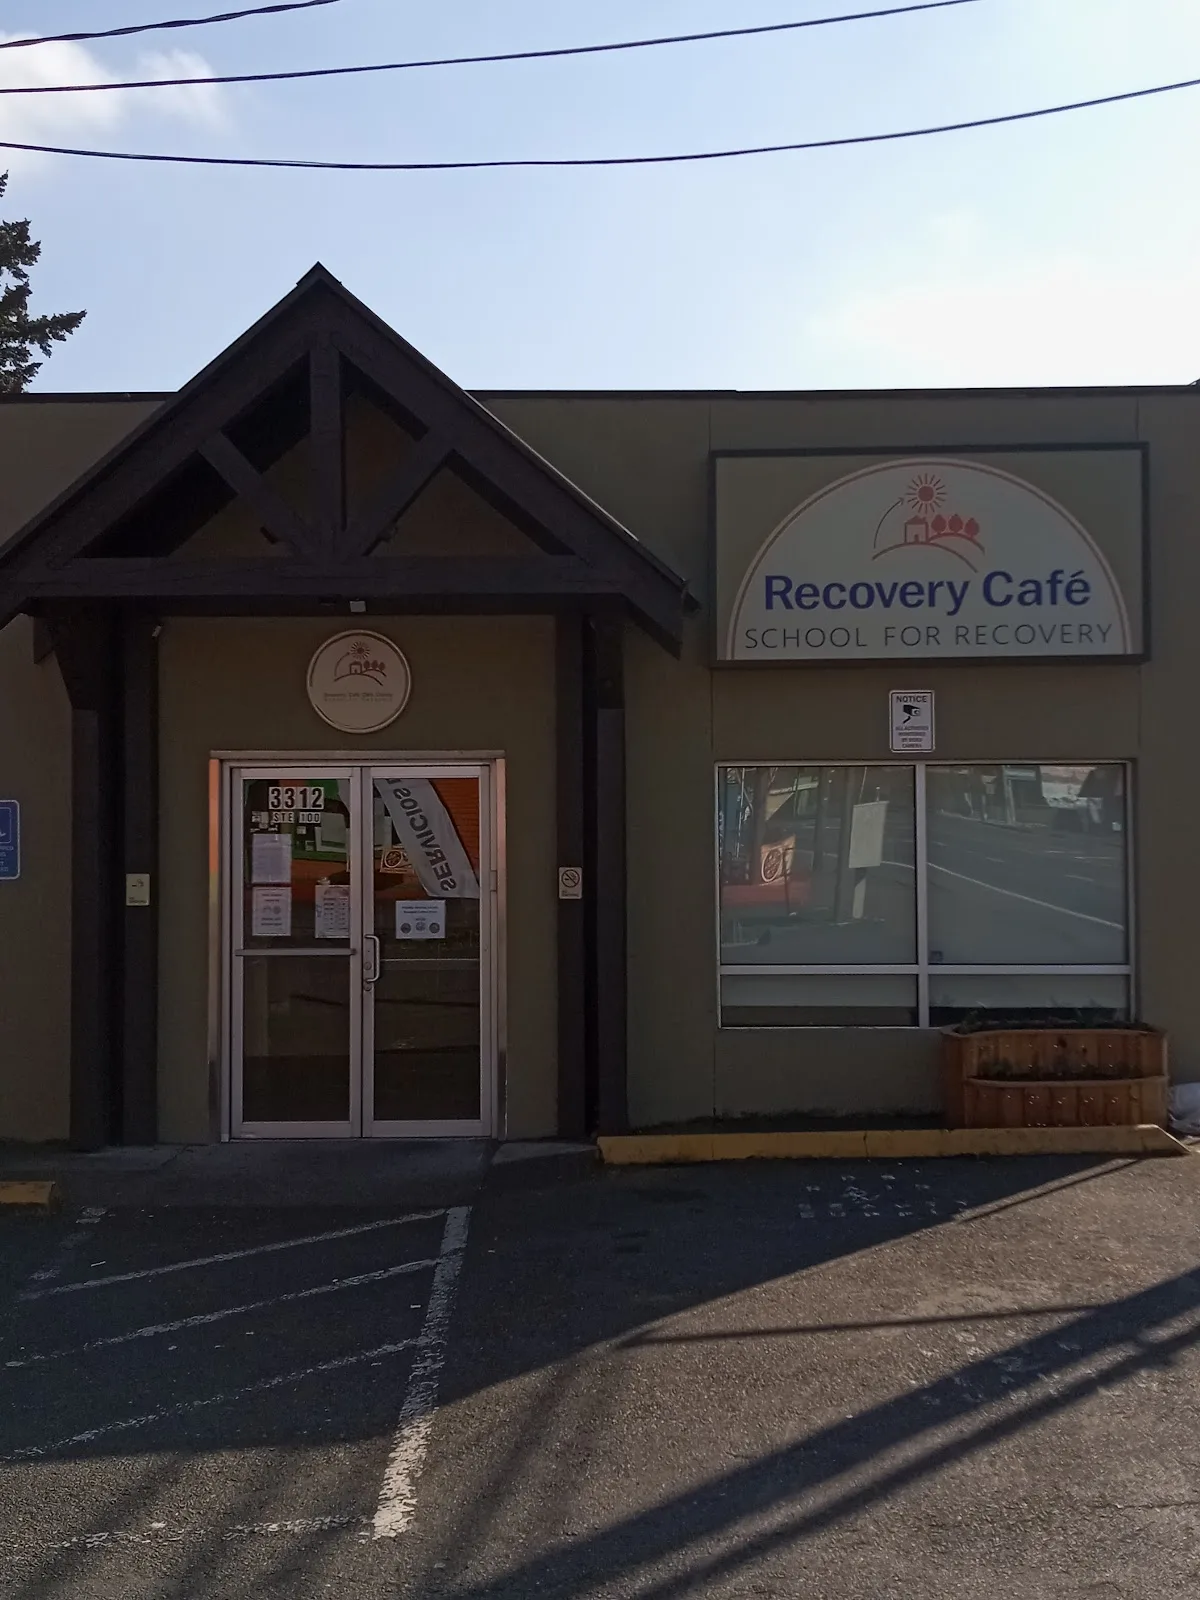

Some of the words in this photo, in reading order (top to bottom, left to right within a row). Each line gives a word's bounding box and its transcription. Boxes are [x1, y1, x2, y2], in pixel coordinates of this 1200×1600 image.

[765, 576, 970, 616] Recovery
[982, 569, 1092, 608] Café
[745, 628, 868, 649] SCHOOL
[884, 626, 940, 647] FOR
[955, 624, 1113, 645] RECOVERY
[896, 695, 928, 703] NOTICE
[270, 787, 322, 809] 3312
[274, 812, 293, 823] STE
[301, 812, 320, 823] 100
